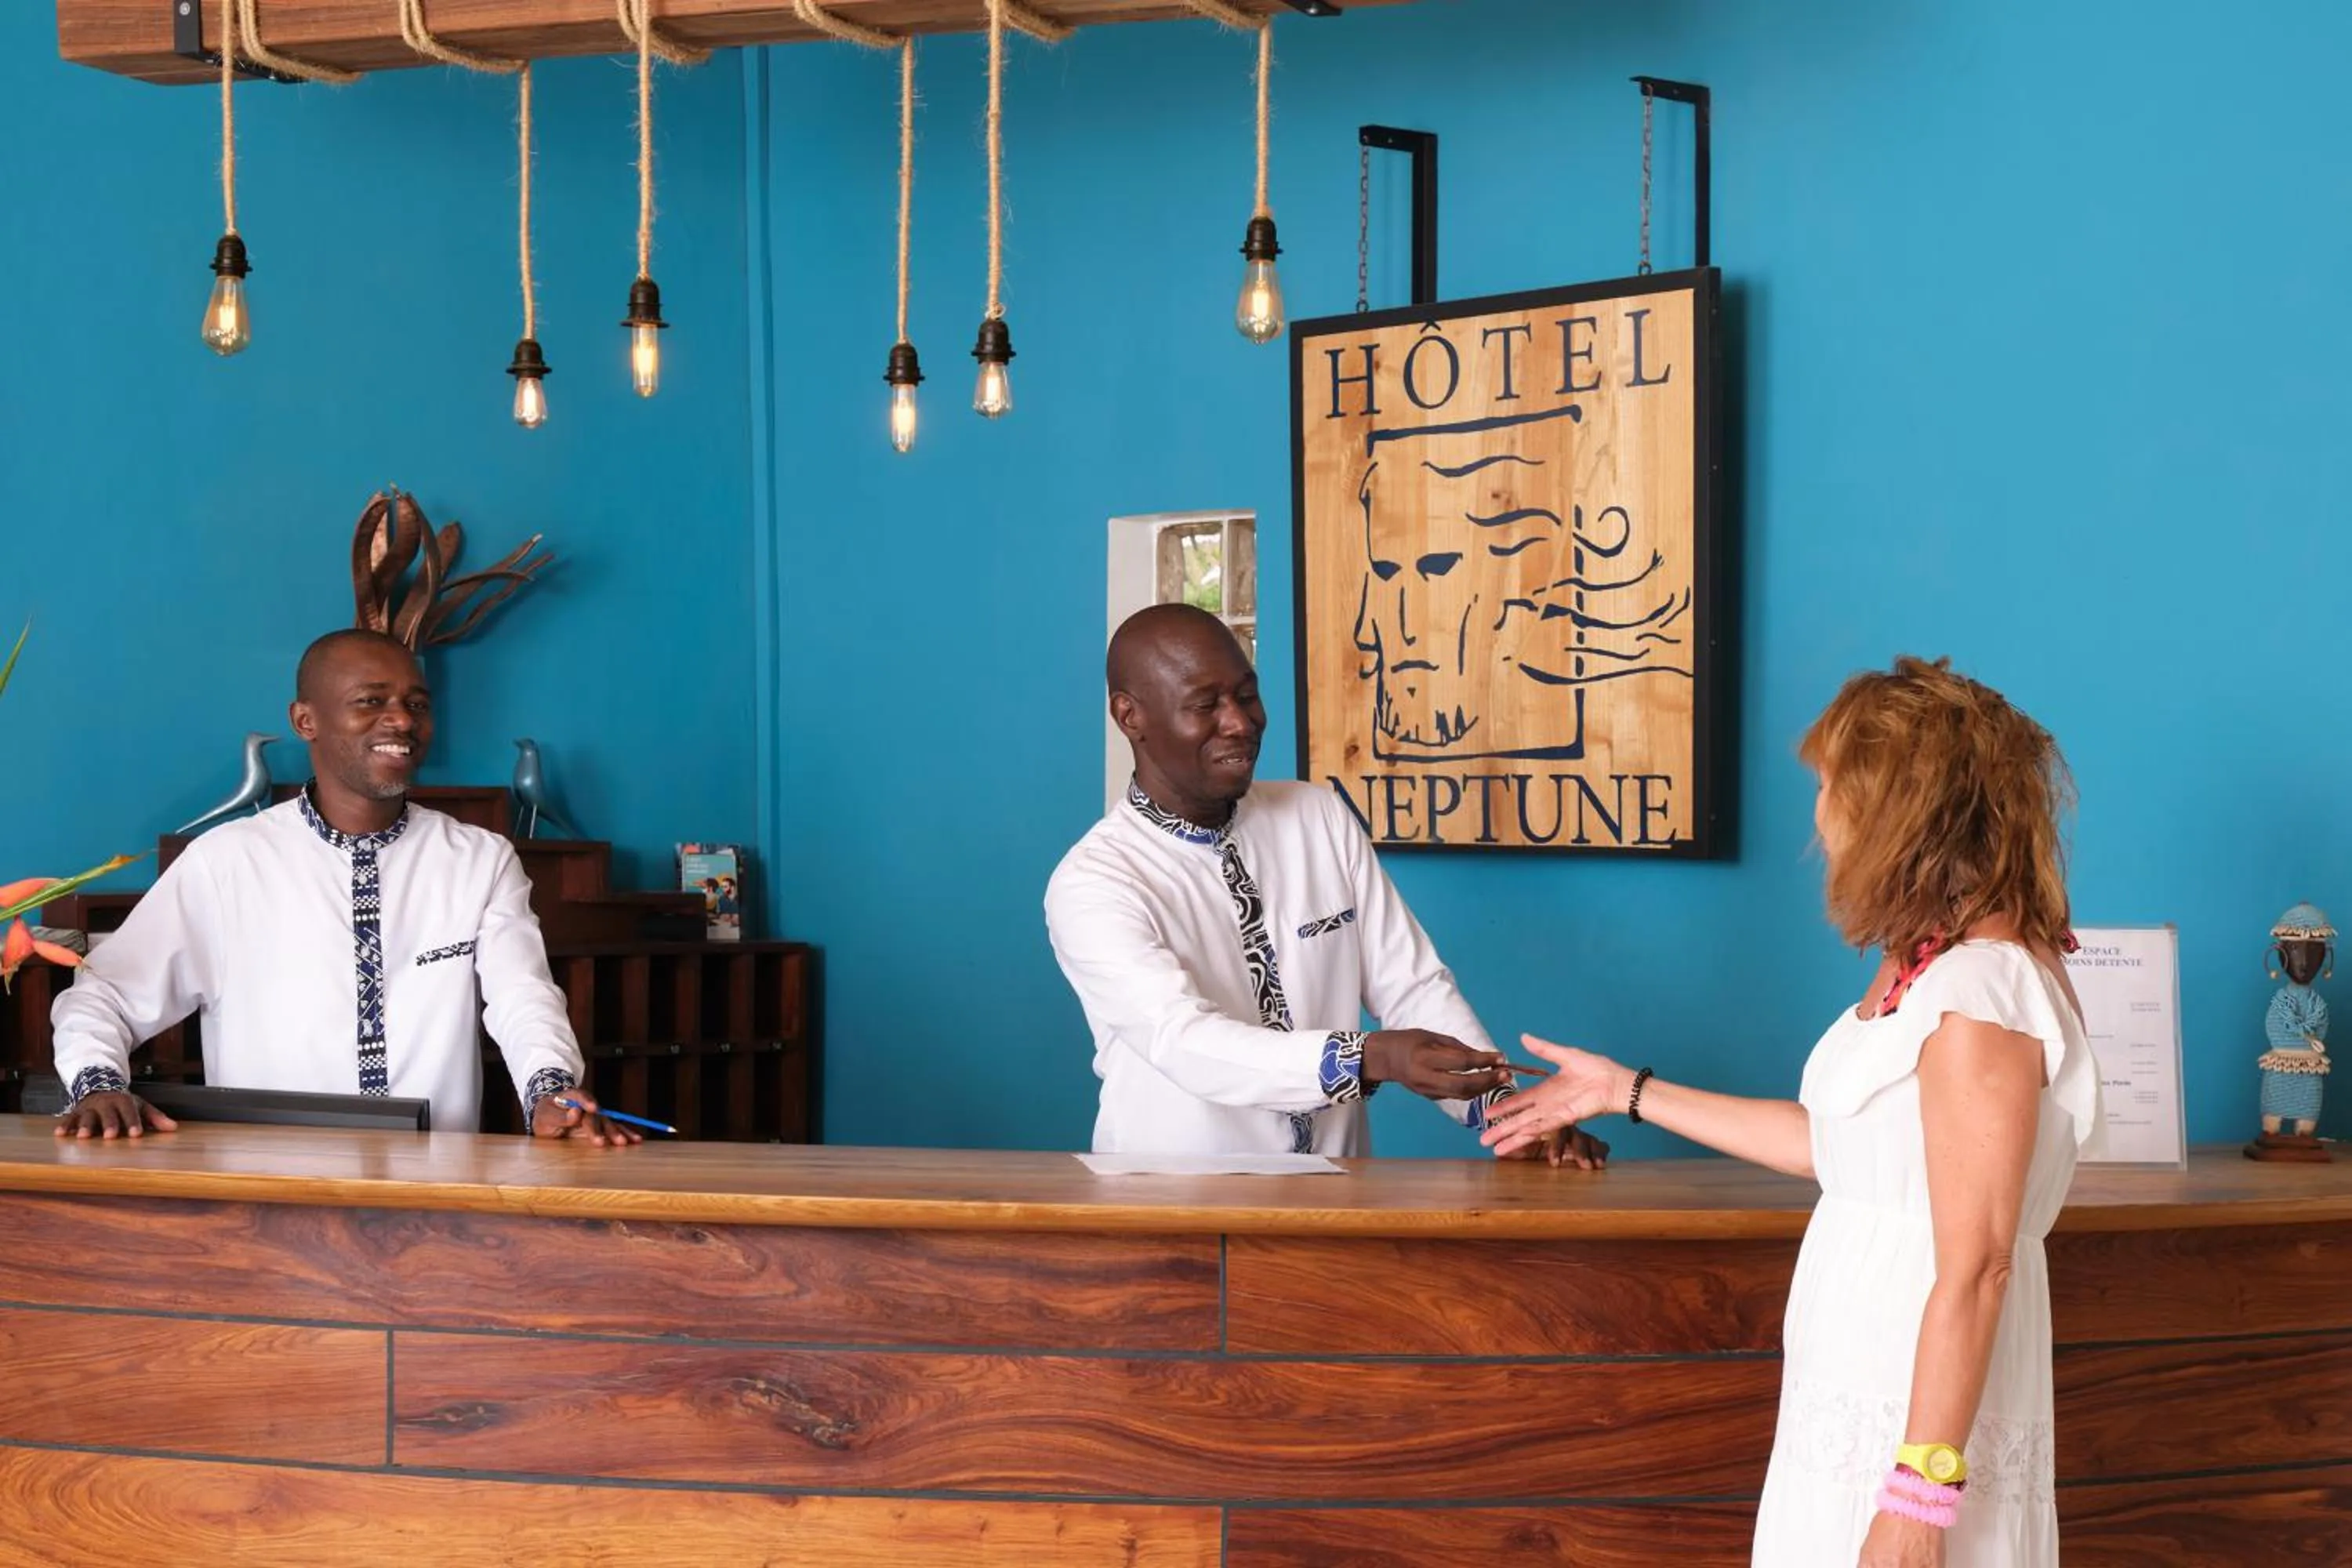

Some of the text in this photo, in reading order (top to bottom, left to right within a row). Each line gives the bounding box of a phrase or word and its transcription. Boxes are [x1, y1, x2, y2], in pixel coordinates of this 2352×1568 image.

[1324, 308, 1671, 419] HÔTEL
[1326, 773, 1676, 844] NEPTUNE
[2082, 946, 2121, 955] ESPACE
